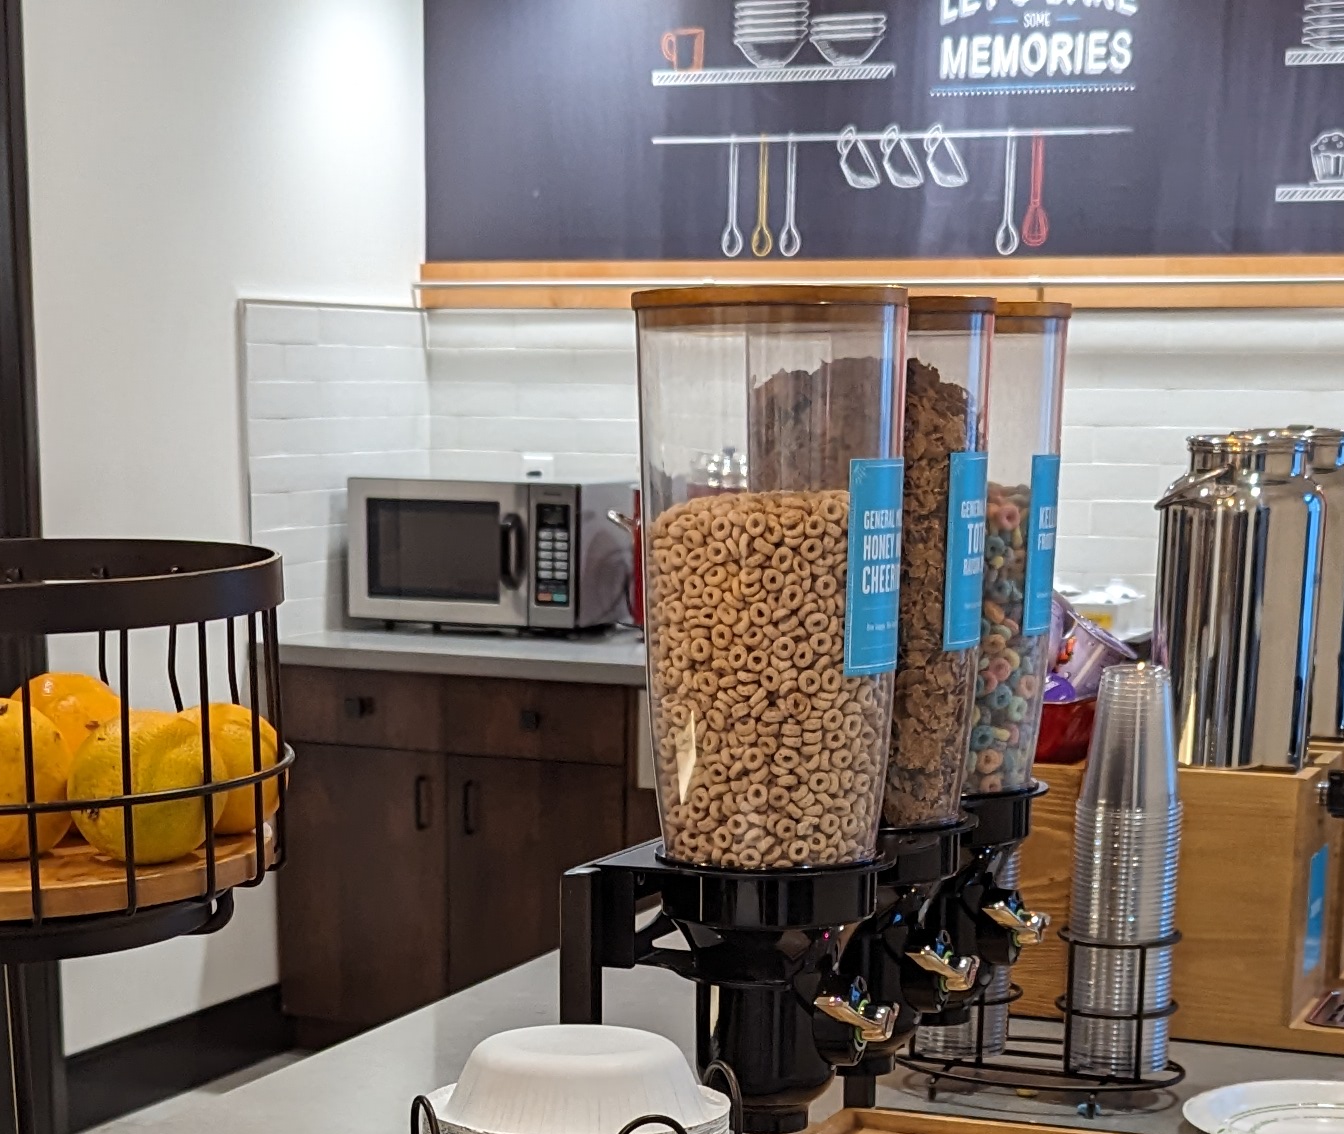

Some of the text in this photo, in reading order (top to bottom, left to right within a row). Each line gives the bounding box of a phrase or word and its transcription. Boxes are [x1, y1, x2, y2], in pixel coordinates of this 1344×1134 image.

[1023, 12, 1052, 28] SOME
[939, 29, 1133, 79] MEMORIES
[863, 509, 895, 530] GENERAL
[863, 533, 895, 560] HONEY
